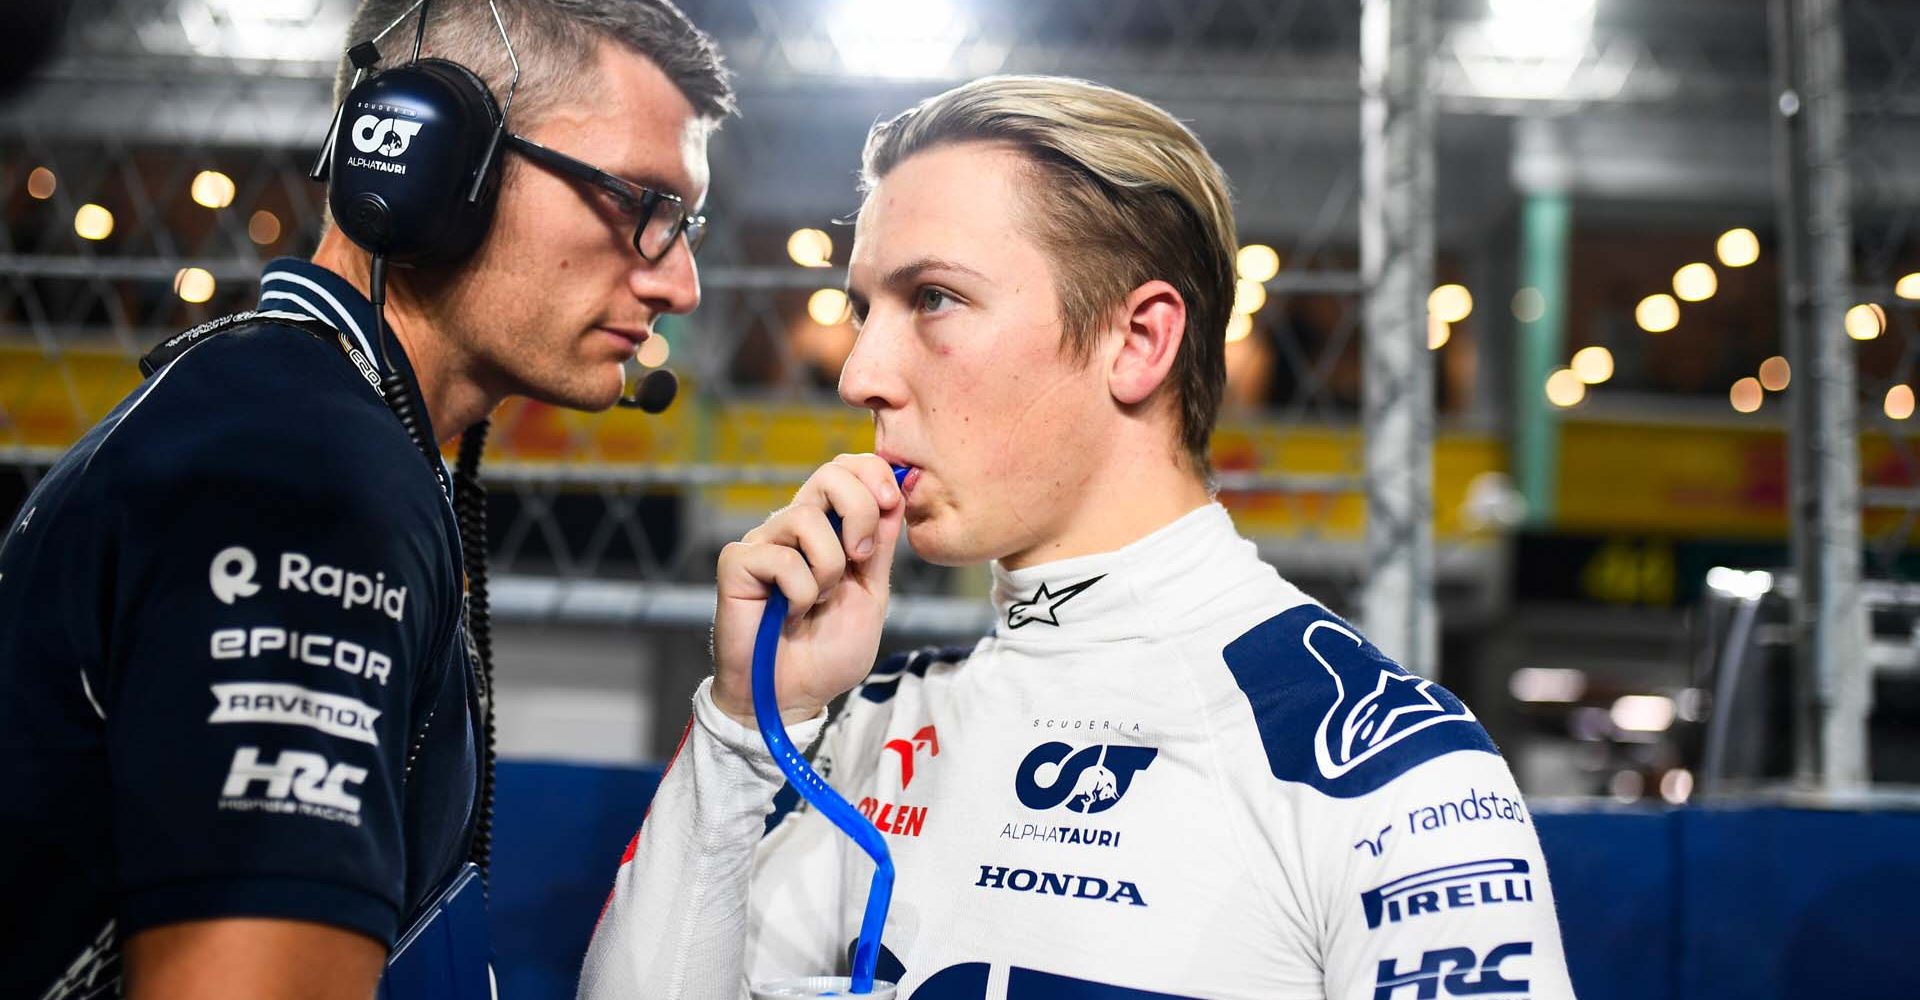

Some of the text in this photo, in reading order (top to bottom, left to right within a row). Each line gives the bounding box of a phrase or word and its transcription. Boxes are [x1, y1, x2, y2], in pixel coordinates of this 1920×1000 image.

[347, 156, 406, 175] ALPHATAURI
[278, 552, 407, 622] Rapid
[1033, 719, 1140, 732] SCUDERIA
[222, 747, 368, 813] HRC
[1408, 788, 1525, 834] randstad
[1000, 823, 1121, 848] ALPHATAURI
[975, 865, 1148, 907] HONDA
[1360, 858, 1534, 930] PIRELLI
[1373, 941, 1533, 1000] HRC
